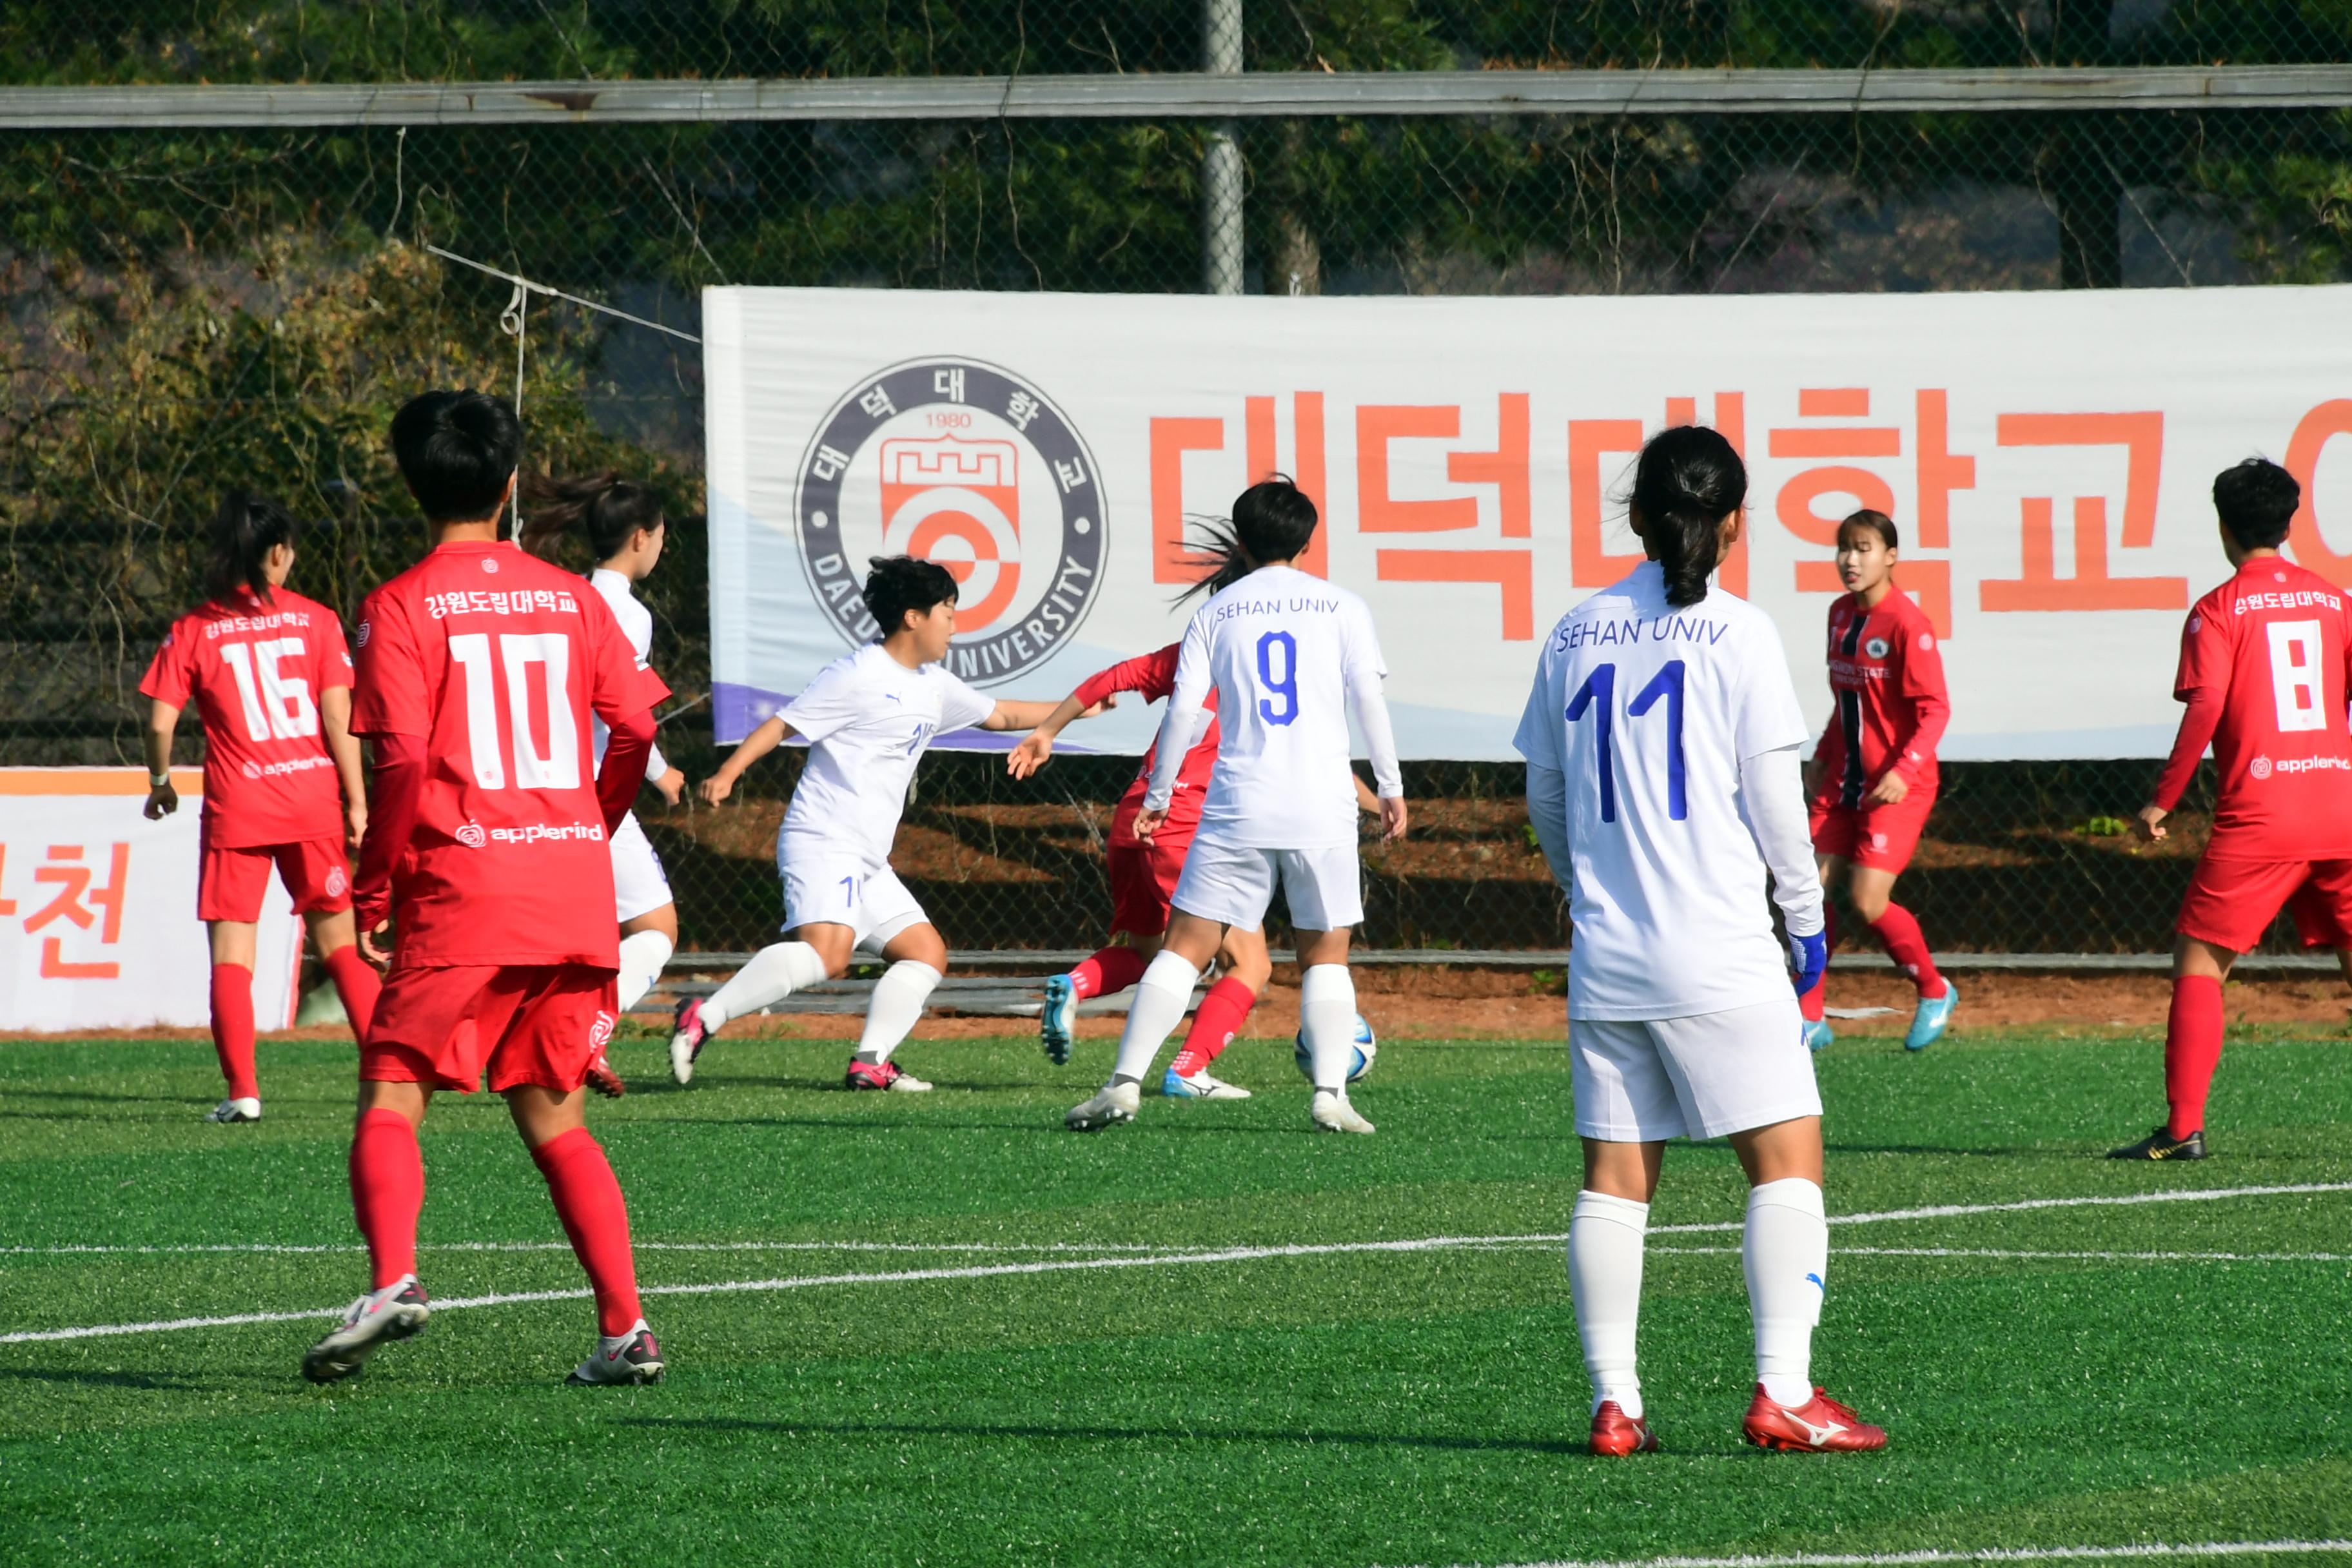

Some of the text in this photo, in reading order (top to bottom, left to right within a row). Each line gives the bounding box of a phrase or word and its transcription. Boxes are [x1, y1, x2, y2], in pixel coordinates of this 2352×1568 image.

[926, 413, 972, 429] 1980
[1150, 387, 2189, 641] 대덕대학교
[204, 612, 309, 639] 강원도립대학교
[425, 590, 578, 619] 강원도립대학교
[1217, 598, 1338, 622] SEHAN UNIV
[1556, 616, 1729, 653] SEHAN UNIV
[2234, 591, 2342, 615] 강원도립대학교
[219, 637, 318, 742] 16
[1256, 630, 1299, 726] 9
[2266, 620, 2328, 732] 8
[448, 632, 580, 790] 10
[1565, 659, 1687, 823] 11
